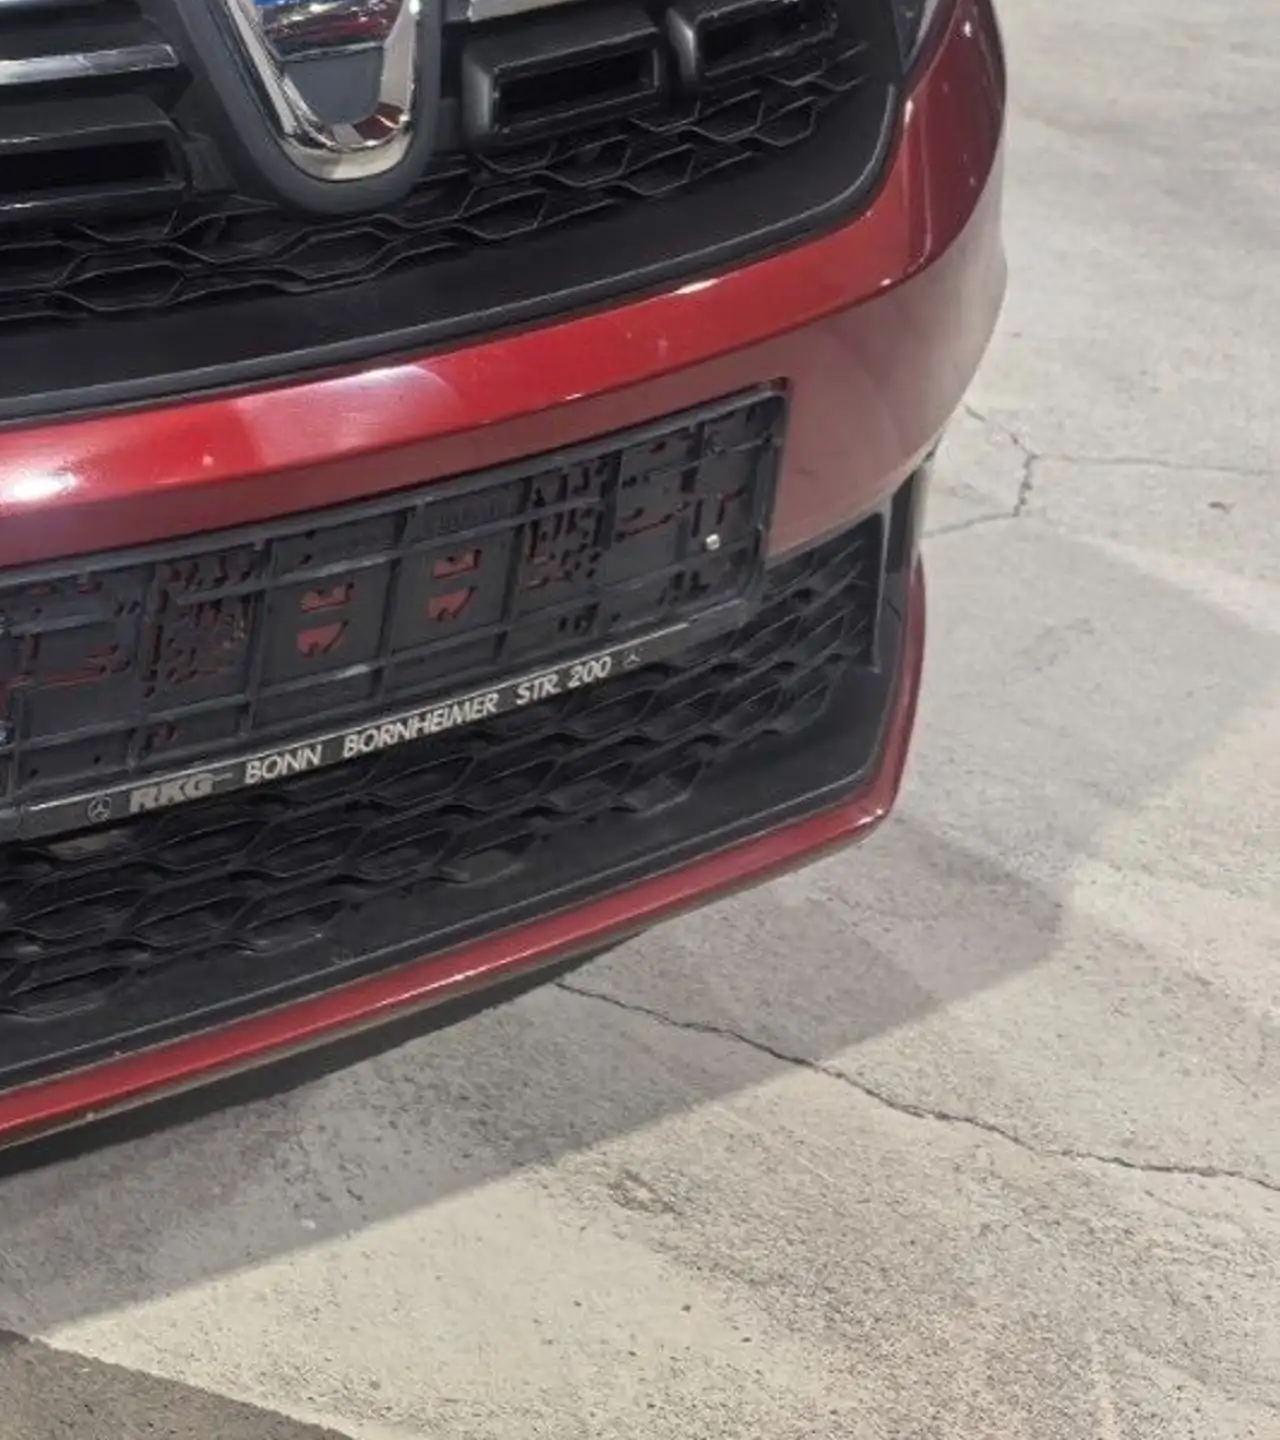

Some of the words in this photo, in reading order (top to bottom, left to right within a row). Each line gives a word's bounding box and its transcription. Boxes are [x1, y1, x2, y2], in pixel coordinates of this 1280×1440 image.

[245, 745, 322, 784] BONN
[343, 692, 499, 758] BORNHEIMER
[568, 656, 613, 688] 200
